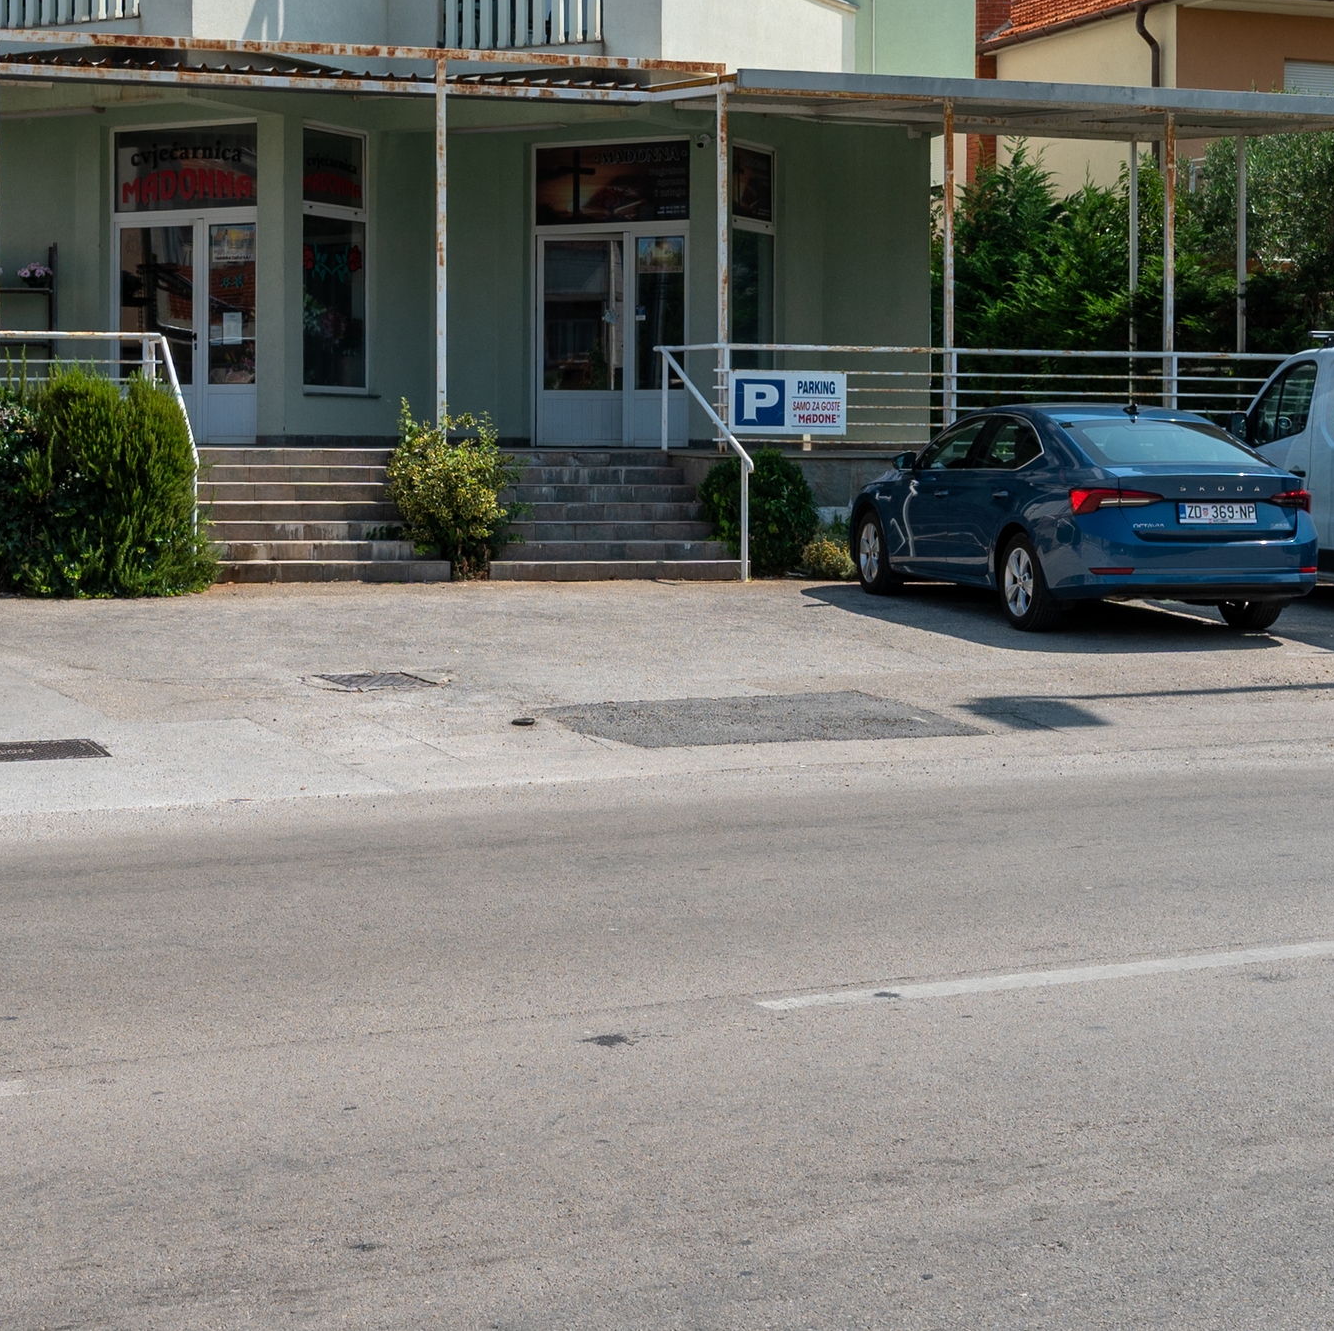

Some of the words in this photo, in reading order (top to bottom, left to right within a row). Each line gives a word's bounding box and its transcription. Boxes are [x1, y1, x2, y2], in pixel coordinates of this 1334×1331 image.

[131, 140, 242, 169] cvjećarnica
[306, 153, 357, 175] cvjećarnica
[600, 146, 680, 165] MADONNA
[122, 167, 253, 206] MADONNA
[303, 171, 362, 199] MADONNA
[797, 380, 836, 395] PARKING
[741, 382, 780, 423] P
[792, 401, 811, 411] SAMO
[811, 401, 820, 411] ZA
[821, 401, 841, 411] GOSTE
[1187, 505, 1202, 519] ZD
[1211, 504, 1255, 520] 369-NP
